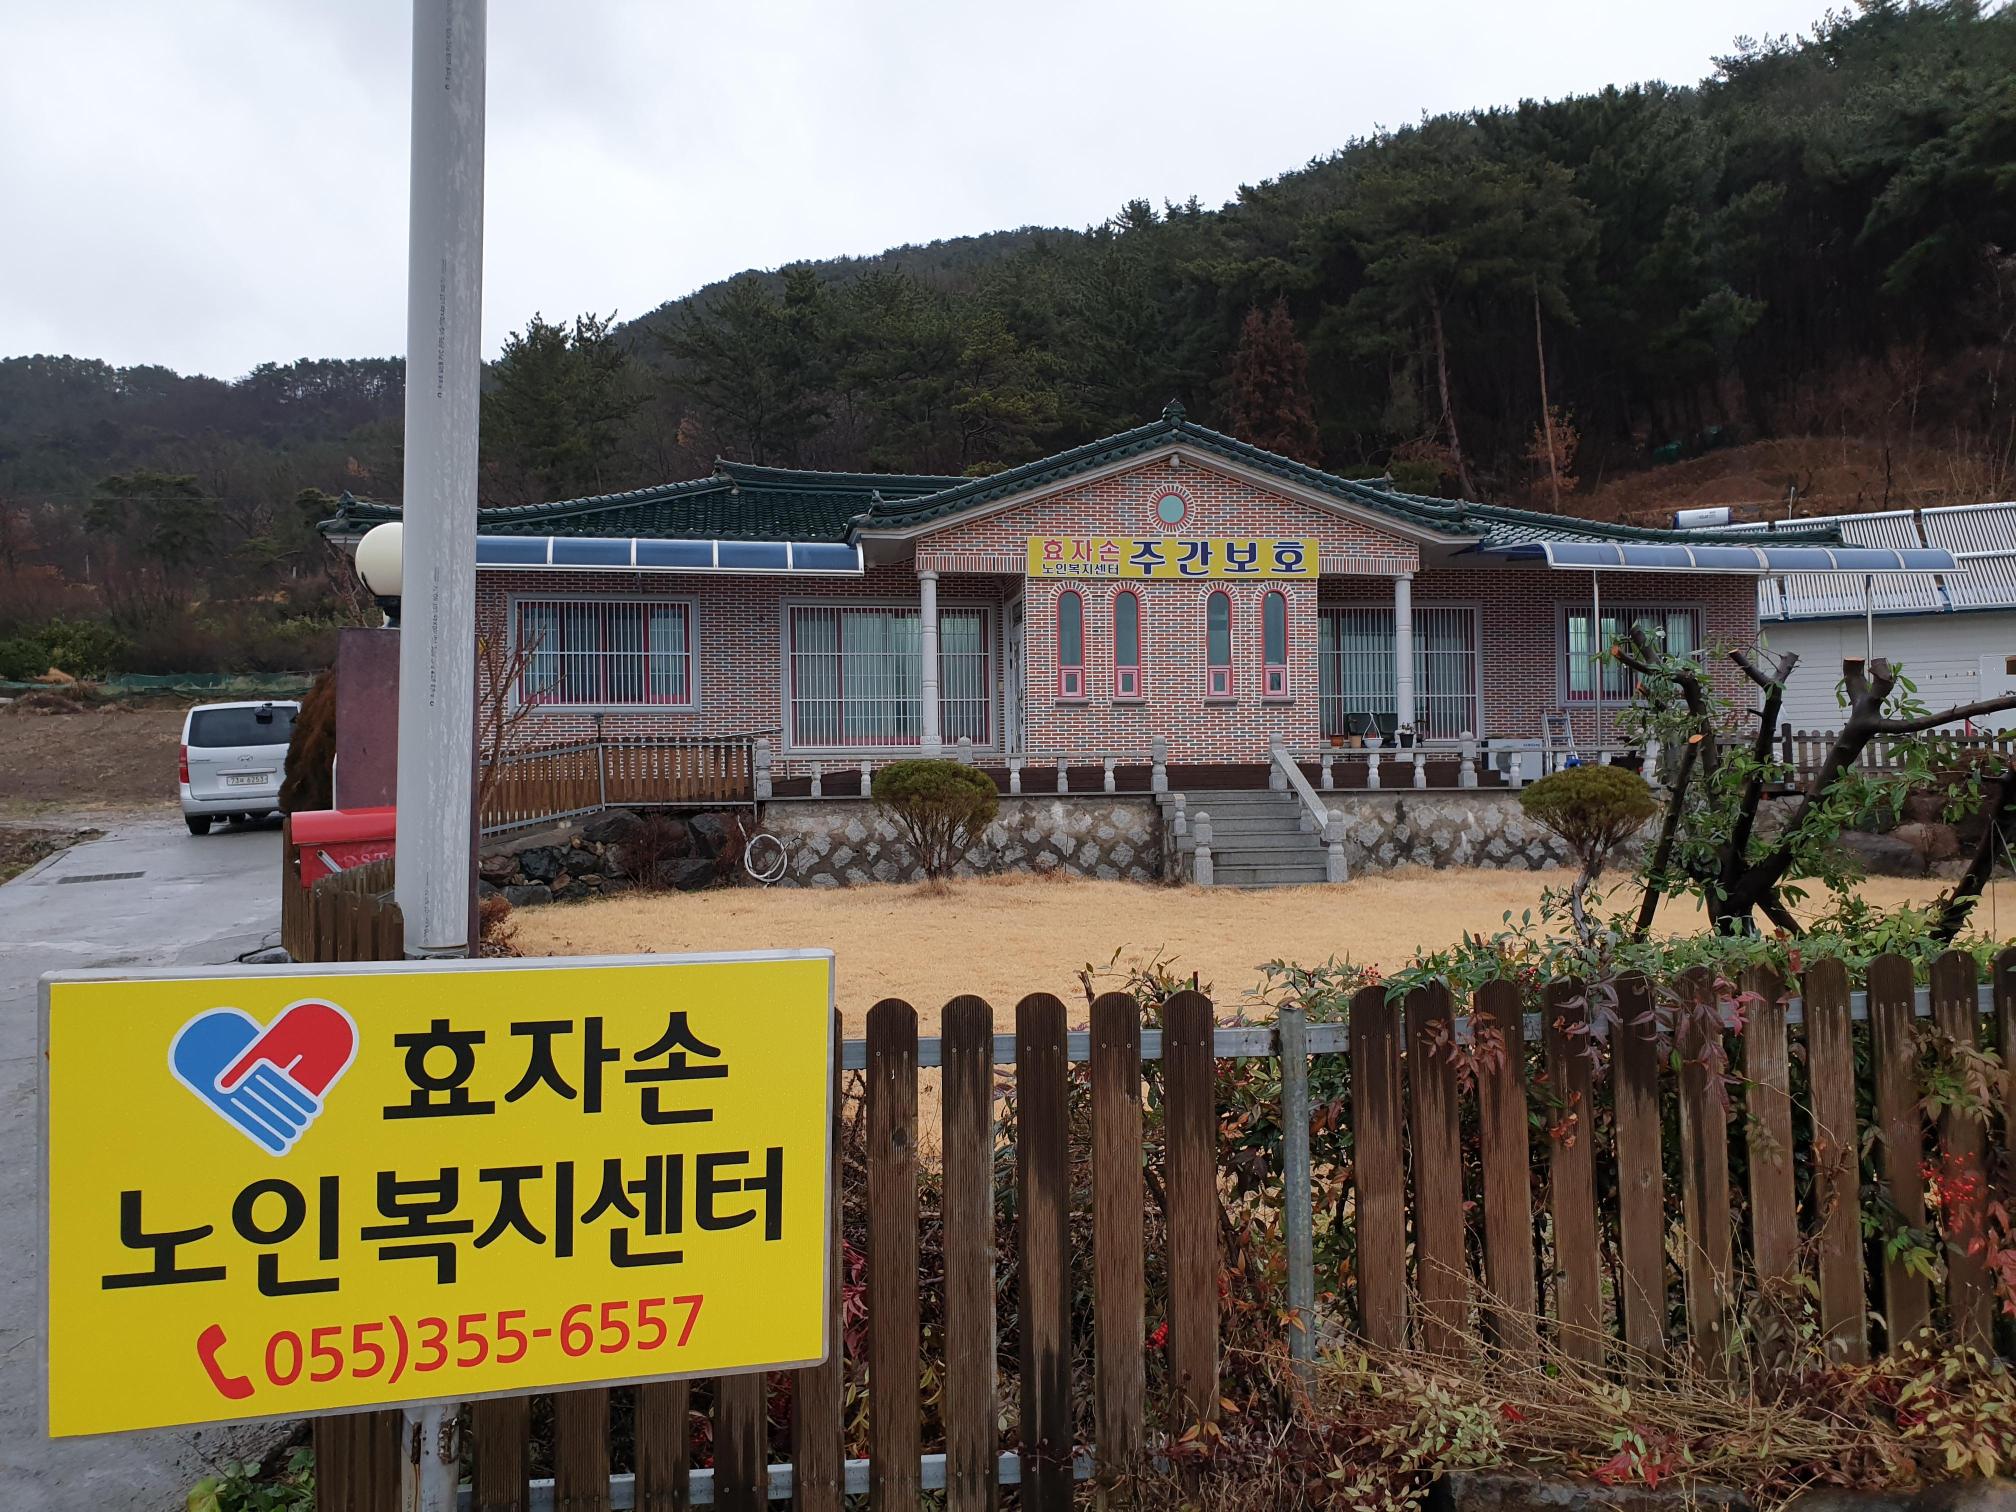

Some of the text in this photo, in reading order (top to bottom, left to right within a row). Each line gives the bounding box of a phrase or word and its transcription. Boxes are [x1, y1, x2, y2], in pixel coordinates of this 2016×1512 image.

[1042, 563, 1119, 576] 노인복지센터
[1043, 540, 1119, 562] 효자손
[1129, 540, 1307, 576] 주간보호
[383, 1011, 729, 1126] 효자손
[101, 1146, 784, 1297] 노인복지센터
[265, 1294, 704, 1386] 055)355-6557
